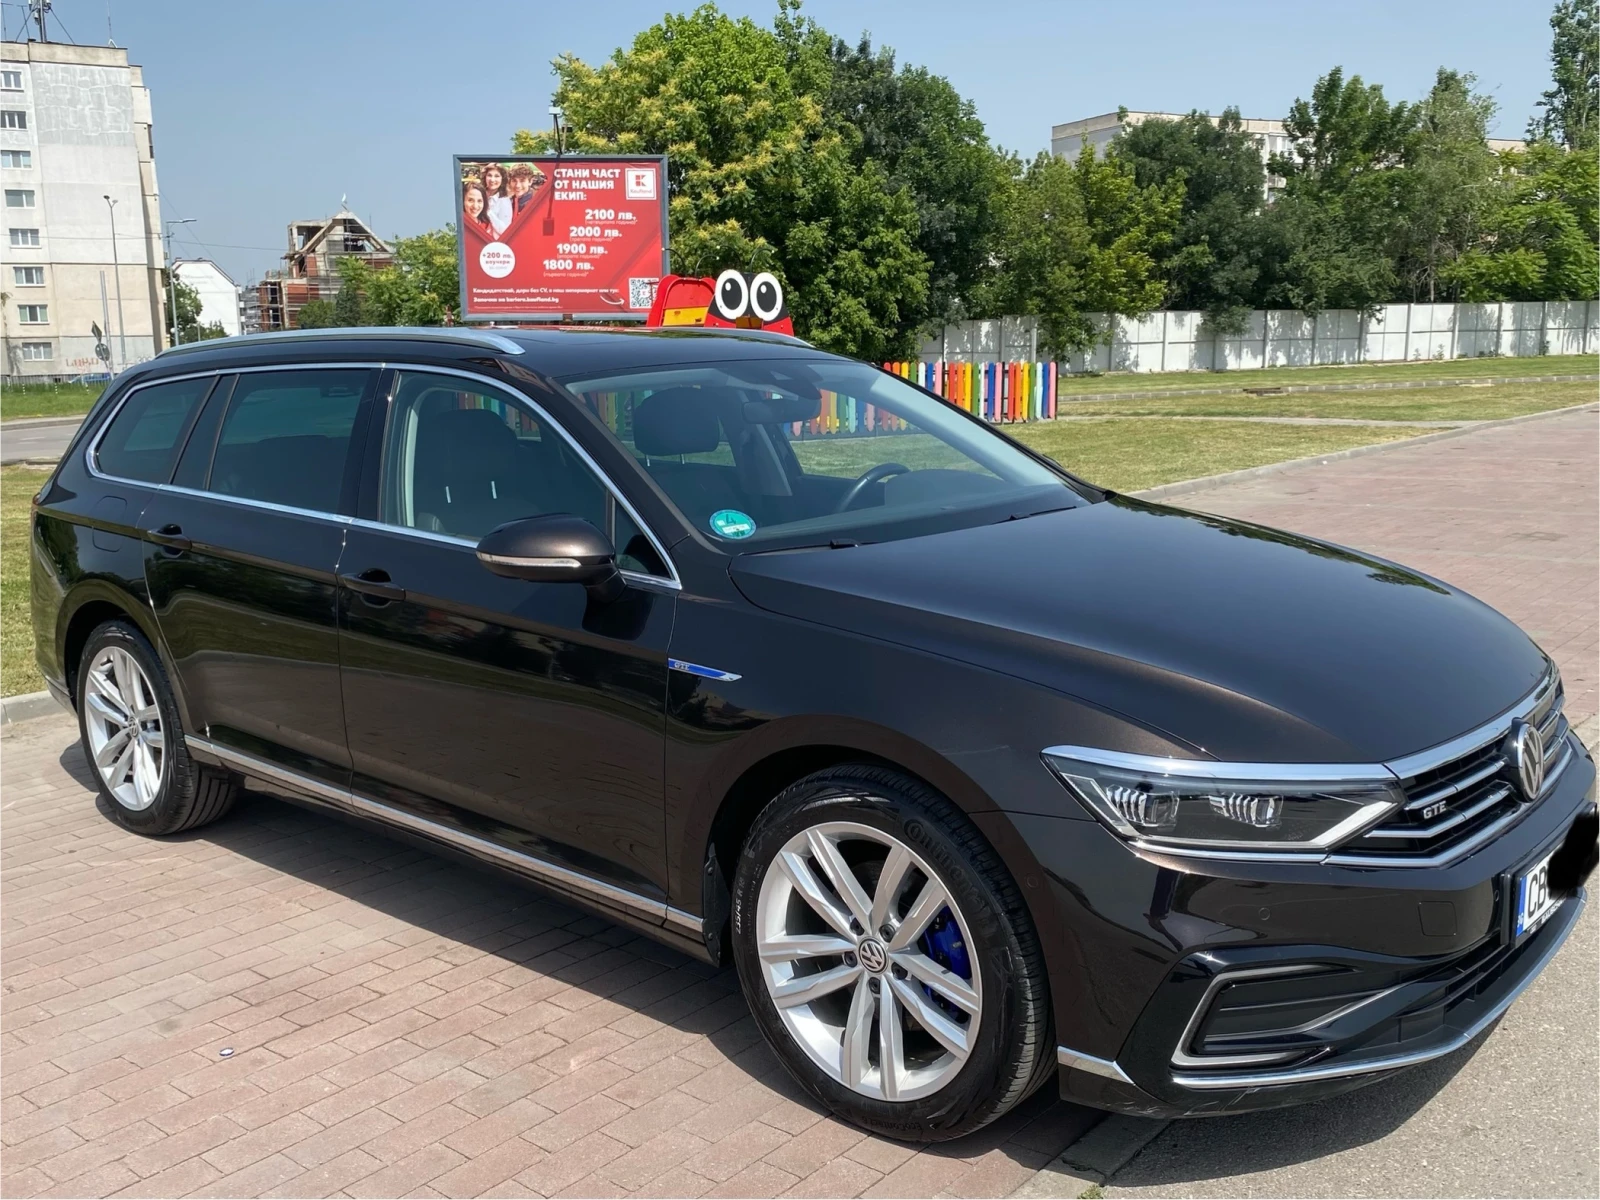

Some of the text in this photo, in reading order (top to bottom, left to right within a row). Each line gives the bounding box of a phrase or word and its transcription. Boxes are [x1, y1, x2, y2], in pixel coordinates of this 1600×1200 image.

[554, 169, 620, 178] СТАНИ ЧАСТ
[554, 180, 614, 189] ОТ НАШИЯ
[554, 192, 587, 200] ЕКИП:
[585, 209, 636, 220] 2100 лв.
[570, 226, 622, 237] 2000 лв.
[557, 243, 608, 254] 1900 лв.
[543, 259, 595, 270] 1800 лв.
[1423, 800, 1447, 820] GTE
